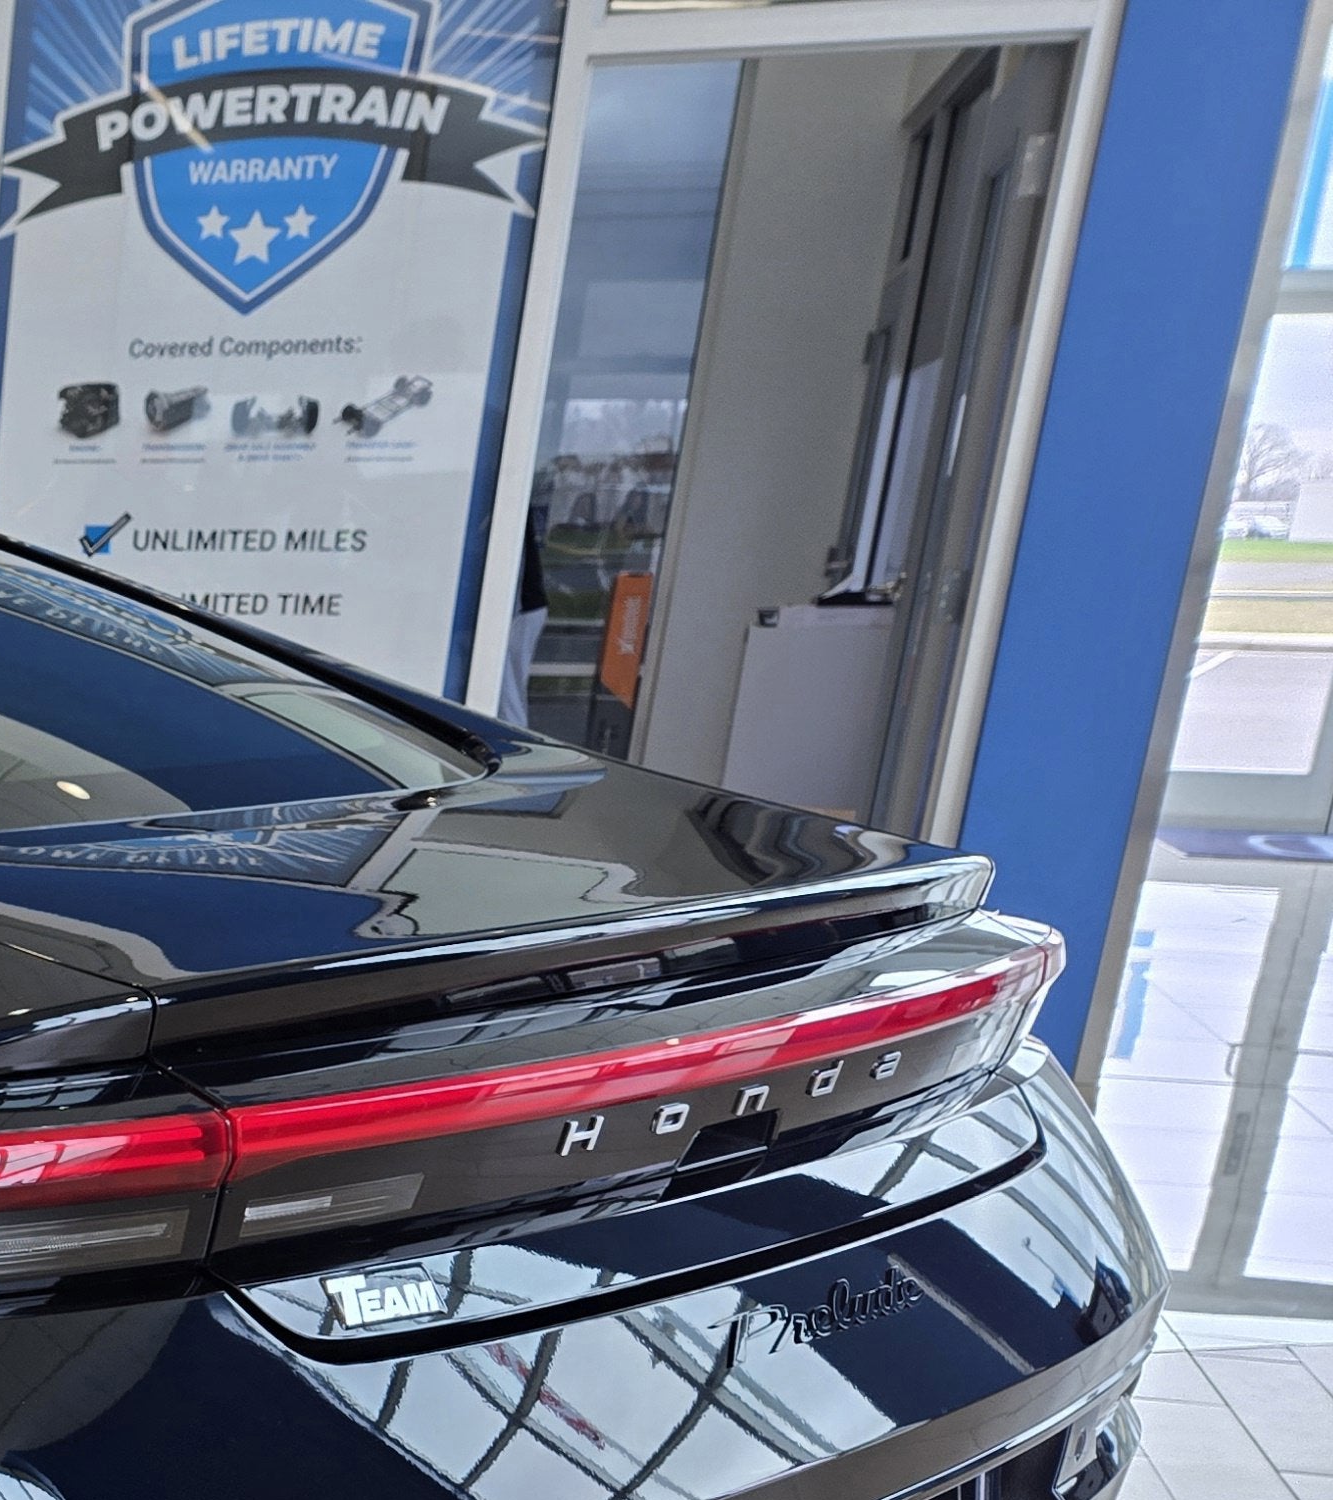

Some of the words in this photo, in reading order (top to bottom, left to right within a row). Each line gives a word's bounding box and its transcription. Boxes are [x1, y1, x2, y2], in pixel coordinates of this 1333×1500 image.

[172, 18, 385, 71] LIFETIME
[96, 83, 450, 152] POWERTRAIN
[189, 154, 339, 185] WARRANTY
[129, 336, 214, 359] Covered
[219, 335, 363, 361] Components:
[132, 529, 276, 553] UNLIMITED
[283, 530, 367, 553] MILES
[278, 593, 342, 616] TIME
[326, 1274, 440, 1326] TEAM
[707, 1265, 925, 1369] Prelude
